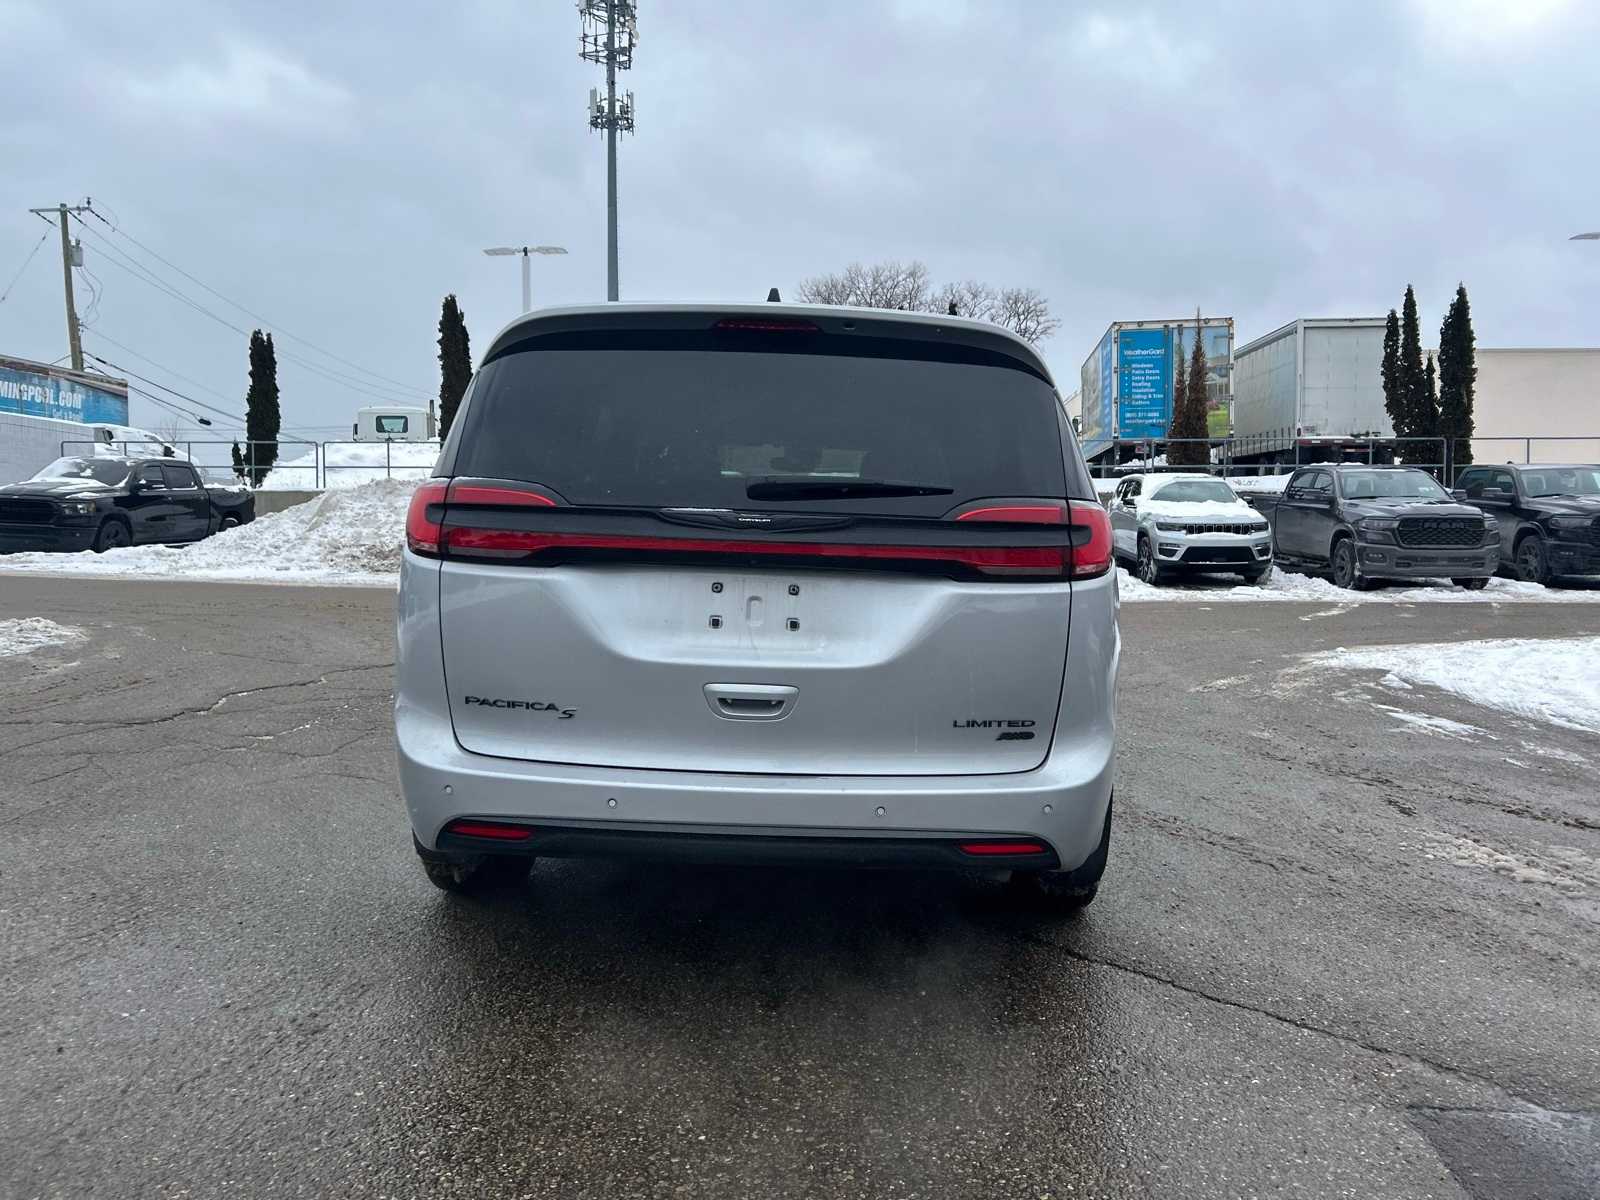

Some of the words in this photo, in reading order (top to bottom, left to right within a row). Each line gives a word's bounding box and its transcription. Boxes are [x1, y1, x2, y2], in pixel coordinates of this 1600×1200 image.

[464, 695, 560, 711] PACIFICA
[557, 709, 577, 719] S
[952, 719, 1036, 728] LIMITED
